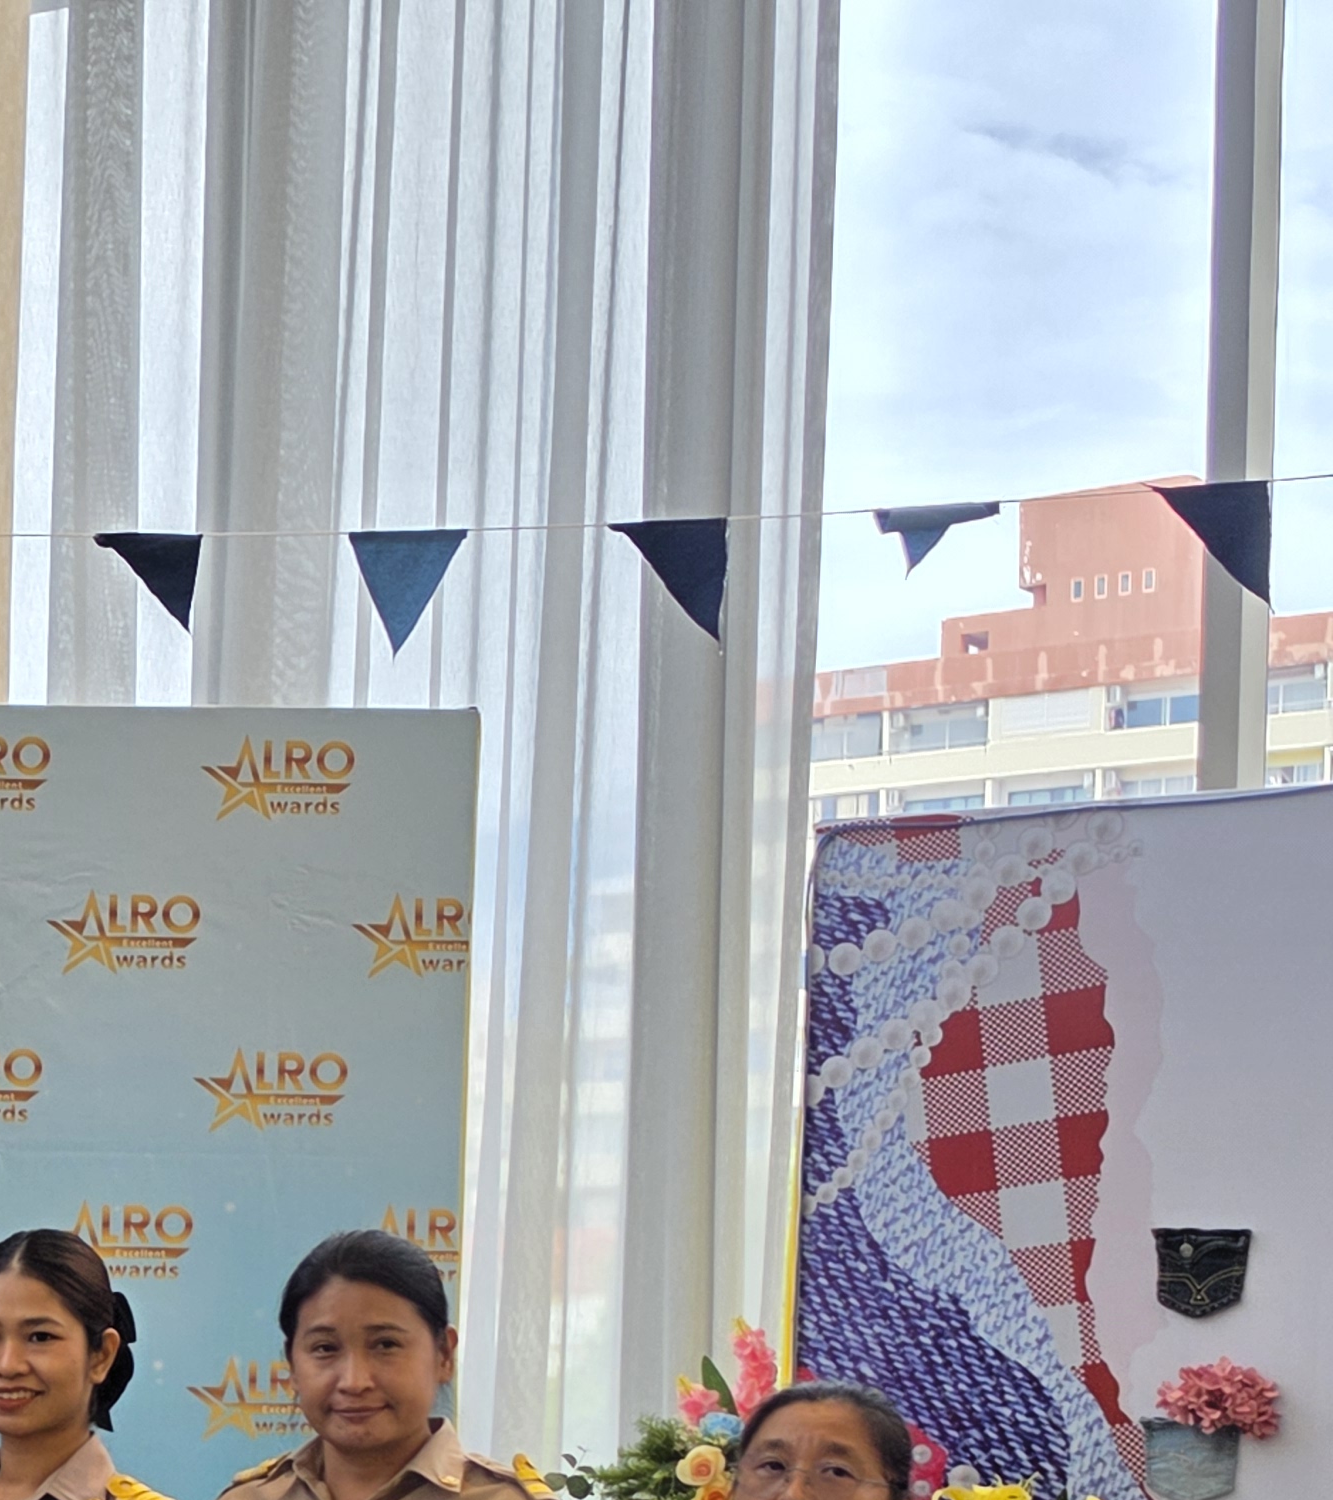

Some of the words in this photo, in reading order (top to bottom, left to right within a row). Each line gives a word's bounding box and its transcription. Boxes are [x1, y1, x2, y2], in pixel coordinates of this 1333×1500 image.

[207, 735, 355, 782] ALRO
[276, 784, 329, 794] Excellent
[52, 889, 201, 936] ALRO
[357, 892, 463, 938] ALR
[122, 938, 174, 948] Excellent
[198, 1047, 348, 1092] ALRO
[269, 1095, 321, 1105] Excellent
[71, 1200, 193, 1245] ALRO
[380, 1203, 458, 1248] ALR
[115, 1248, 166, 1258] Excellent
[191, 1357, 294, 1400] ALR
